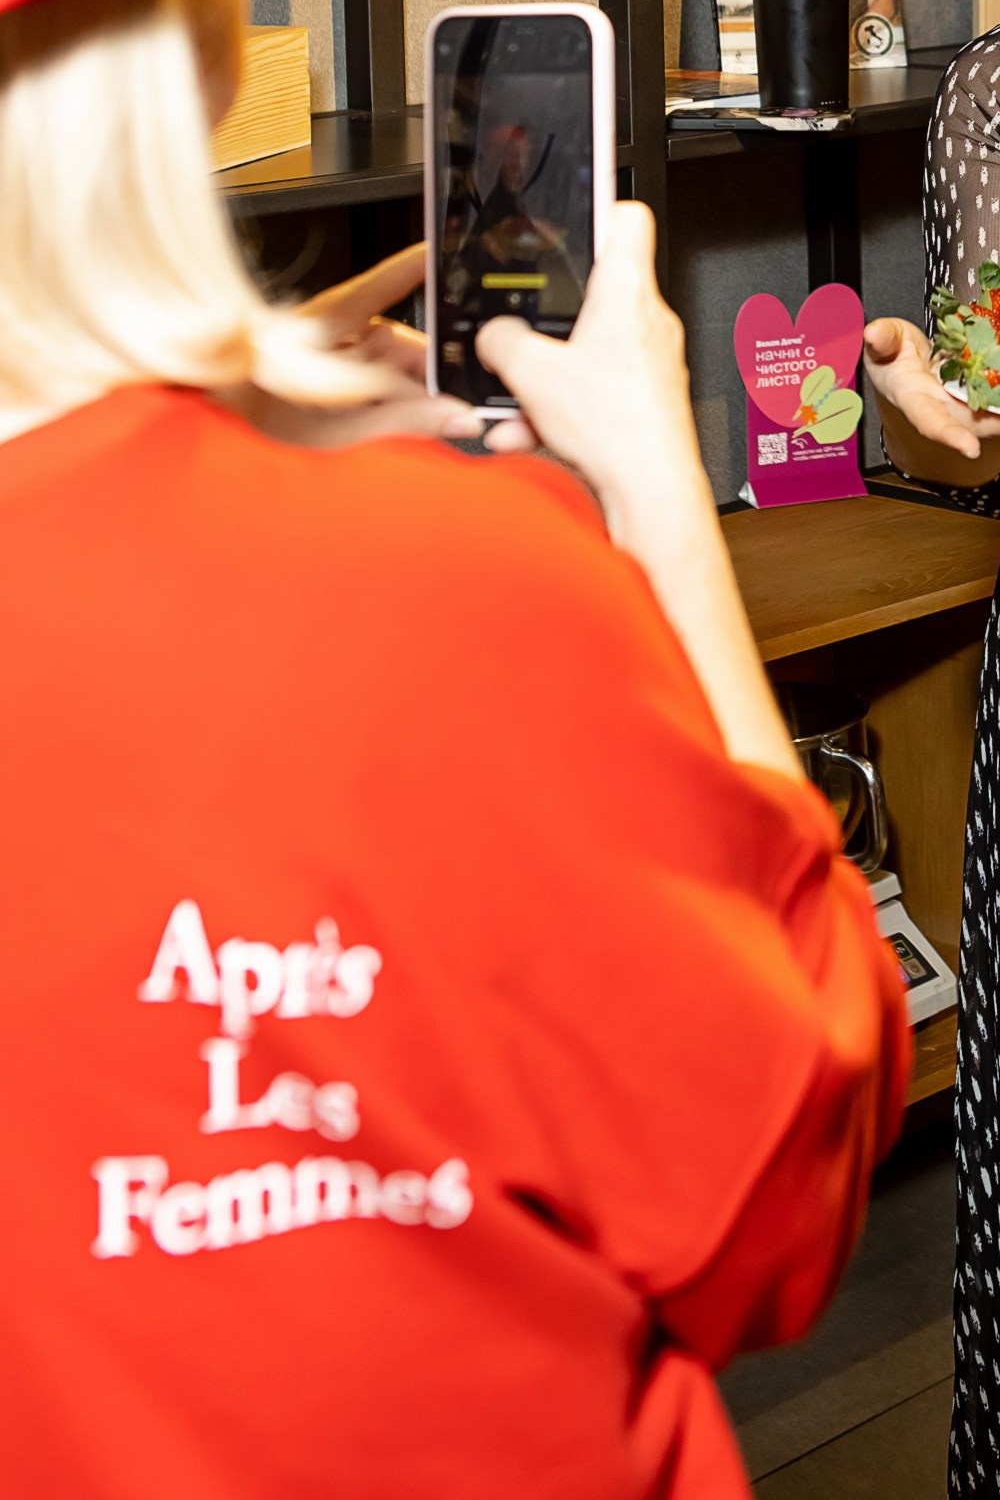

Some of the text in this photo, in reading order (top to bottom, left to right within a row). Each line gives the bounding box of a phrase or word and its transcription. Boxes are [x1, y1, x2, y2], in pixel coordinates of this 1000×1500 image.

[755, 346, 816, 361] начни с
[755, 359, 817, 374] чистого
[755, 374, 800, 388] листа
